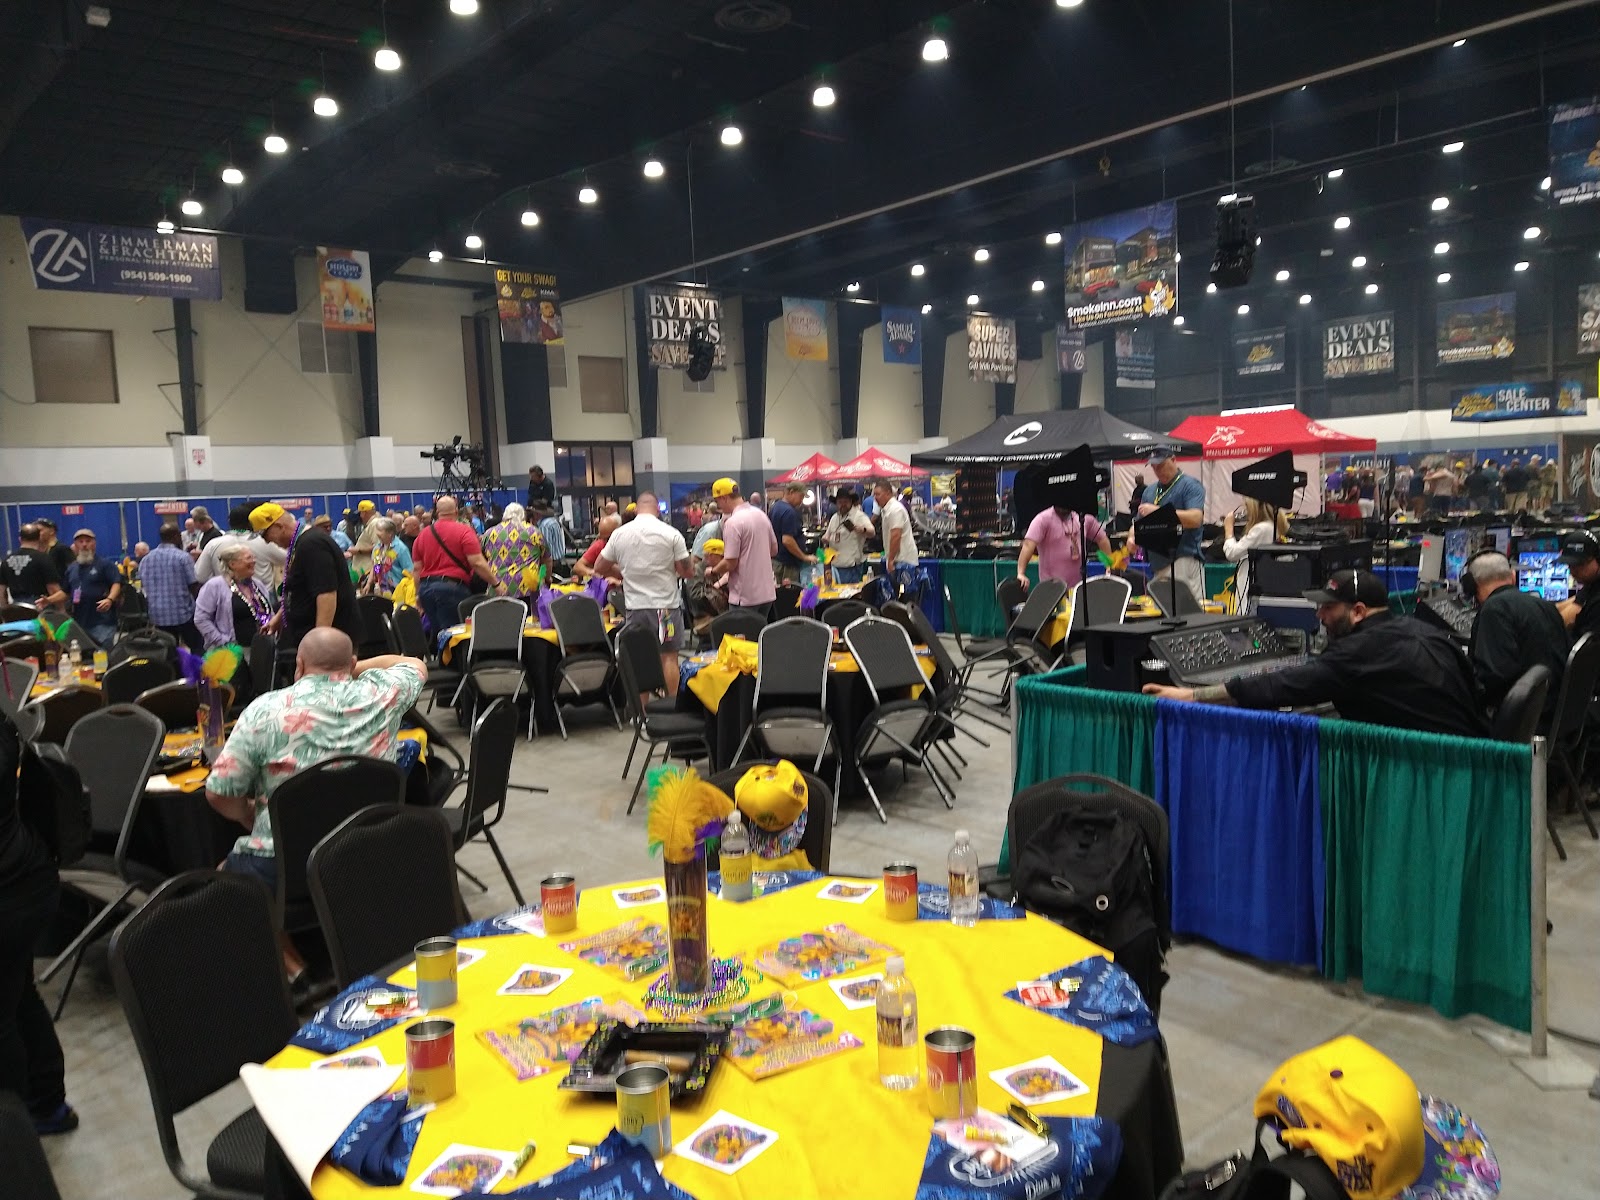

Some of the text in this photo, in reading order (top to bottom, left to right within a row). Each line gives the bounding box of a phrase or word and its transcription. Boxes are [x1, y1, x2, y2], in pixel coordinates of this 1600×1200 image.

[99, 233, 212, 253] ZIMMERMAN
[100, 255, 213, 269] PERSONAL INJURY ATTORNEYS
[121, 269, 192, 284] (954) 509-1900
[497, 269, 557, 287] GET YOUR SWAG!
[649, 294, 719, 320] EVENT
[1104, 307, 1134, 318] Facebook
[974, 324, 1011, 343] SUPER
[1328, 319, 1390, 343] EVENT
[968, 341, 1016, 360] SAVINGS
[1328, 336, 1391, 359] DEALS
[1327, 358, 1361, 376] SAVE
[1498, 387, 1527, 402] SALE
[1506, 397, 1550, 412] CENTER
[1048, 473, 1077, 485] SHURE
[1247, 472, 1278, 481] SHURE
